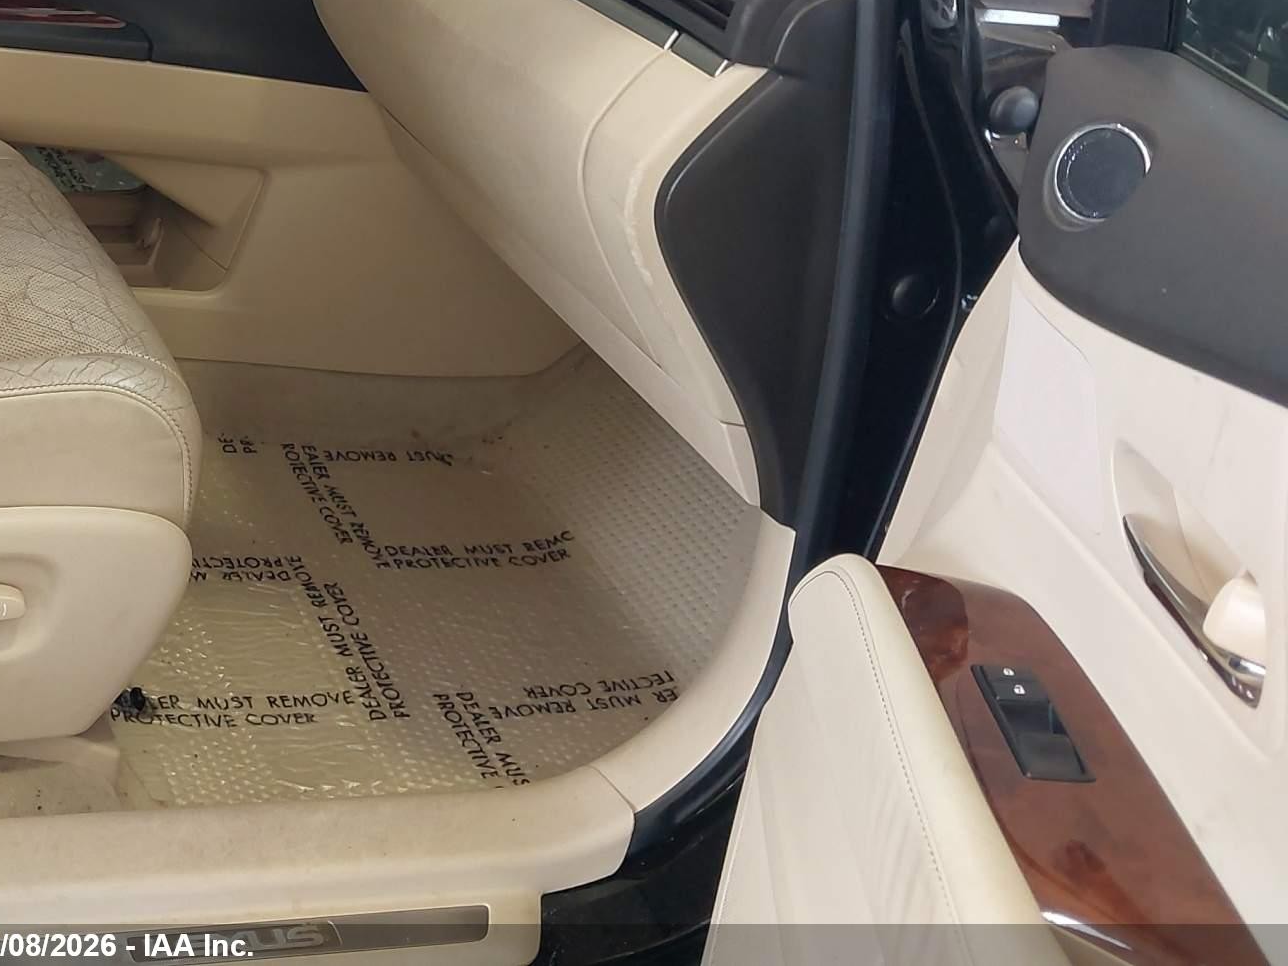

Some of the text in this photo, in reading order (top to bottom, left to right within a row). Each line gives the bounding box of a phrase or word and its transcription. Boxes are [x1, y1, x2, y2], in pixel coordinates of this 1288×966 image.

[323, 450, 397, 462] REMOVE
[324, 485, 357, 517] MUST
[319, 506, 353, 544] COVER
[385, 545, 453, 557] DEALER
[464, 544, 514, 555] MUST
[393, 548, 572, 570] PROTECTIVE COVER
[318, 615, 353, 657] MUST
[324, 582, 411, 718] PROTECTIVE COVER
[197, 695, 253, 711] MUST
[266, 690, 356, 709] REMOVE
[346, 666, 387, 721] DEALER
[523, 682, 592, 699] COVER
[488, 699, 577, 720] REMOVE
[586, 694, 642, 711] MUST
[245, 713, 318, 726] COVER
[456, 692, 502, 745] DEALER
[432, 693, 501, 779] PROTECTIVE
